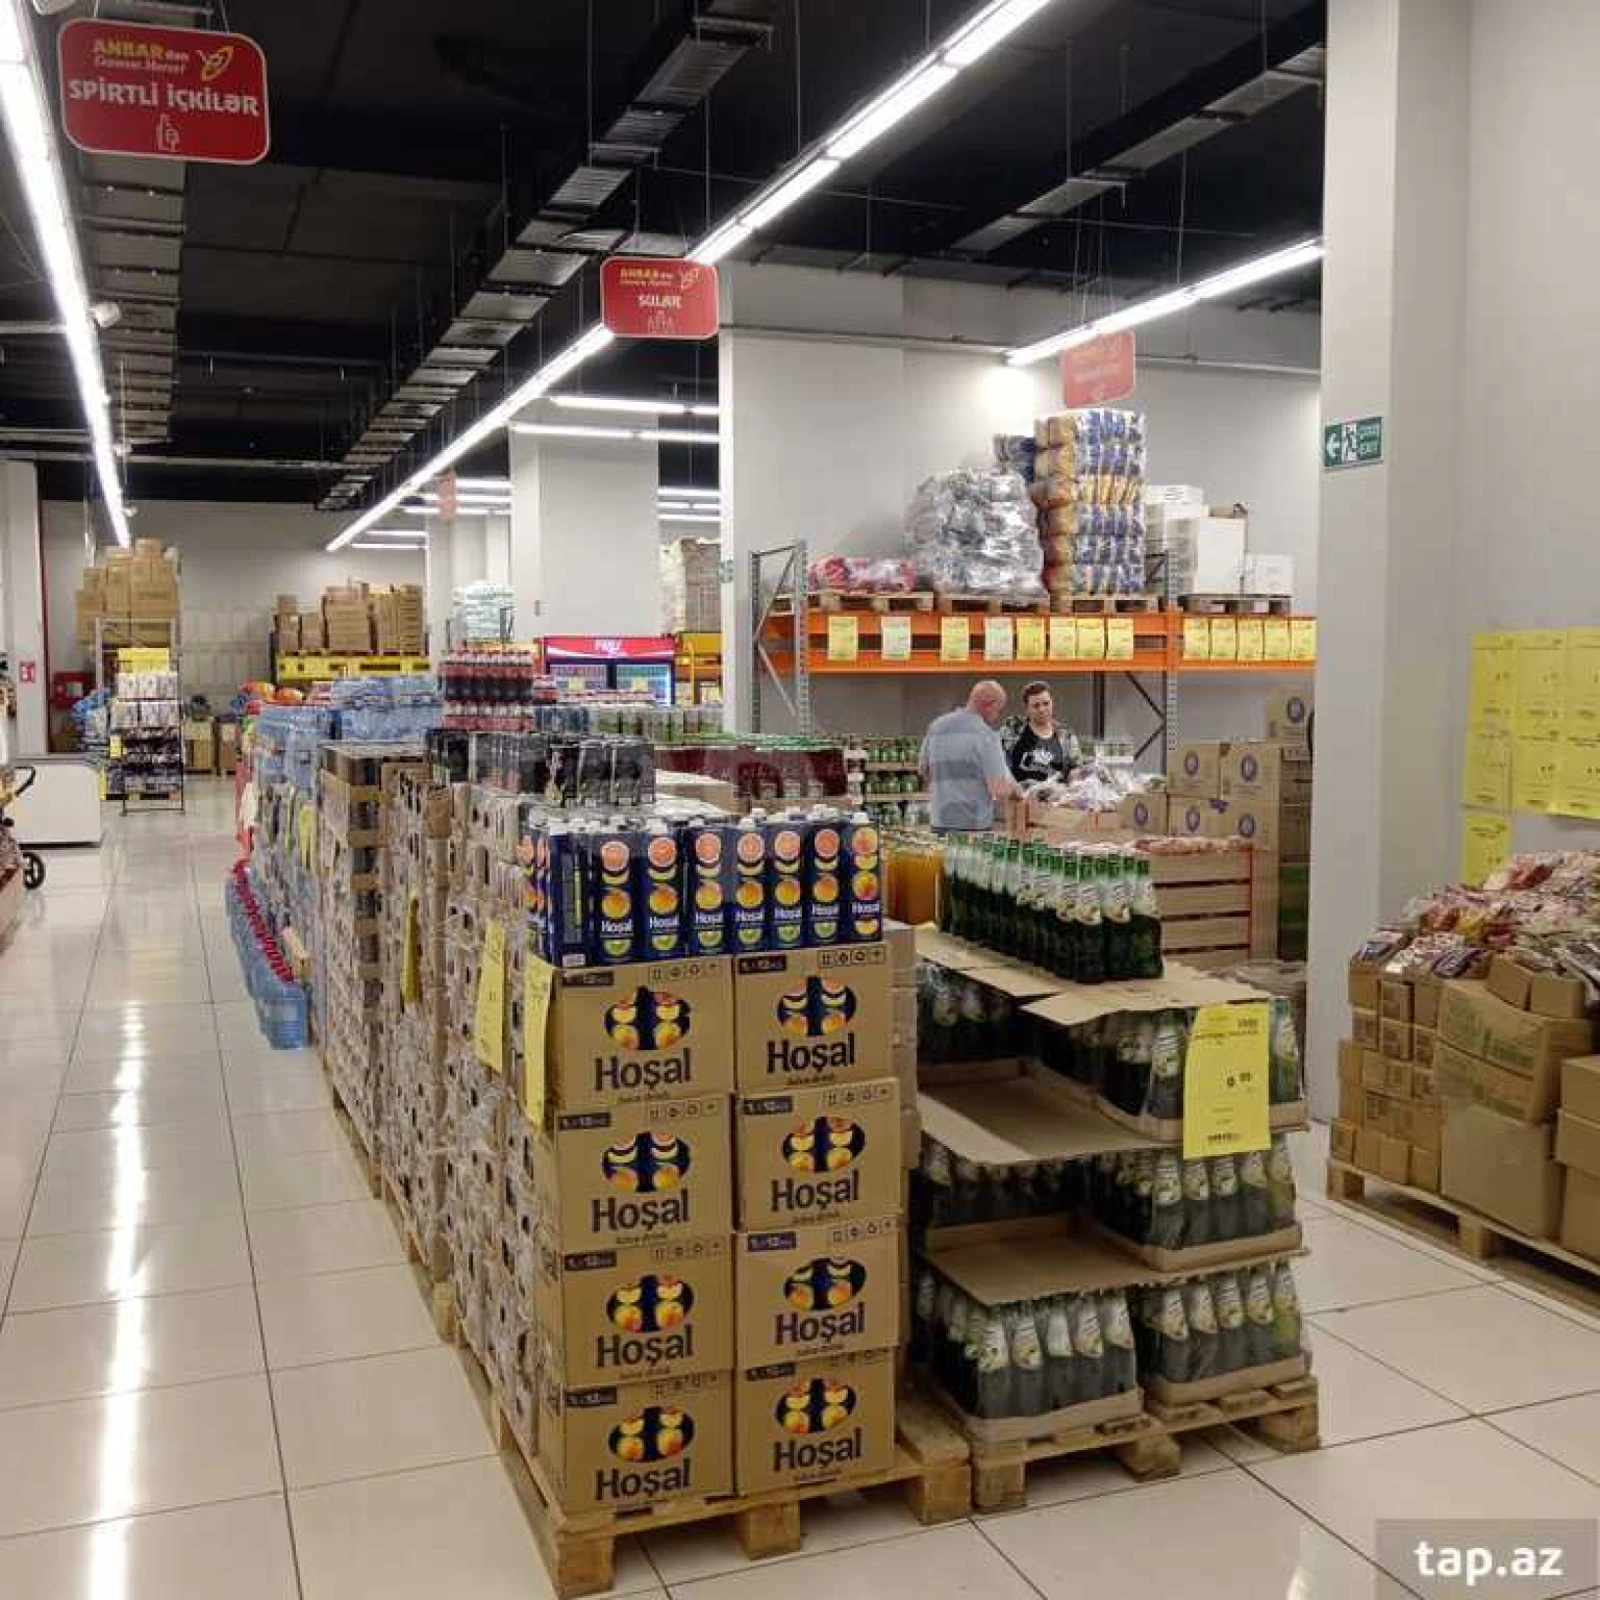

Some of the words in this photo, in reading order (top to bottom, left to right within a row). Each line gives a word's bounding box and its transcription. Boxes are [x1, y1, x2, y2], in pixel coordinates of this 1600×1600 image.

[593, 1048, 690, 1092] Hoşal
[766, 1032, 855, 1074] Hoşal
[591, 1188, 688, 1232] Hoşal
[770, 1168, 859, 1212] Hoşal
[774, 1301, 865, 1345] Hoşal
[596, 1324, 693, 1367] Hoşal
[773, 1427, 861, 1472] Hoşal
[594, 1457, 691, 1501] Hoşal
